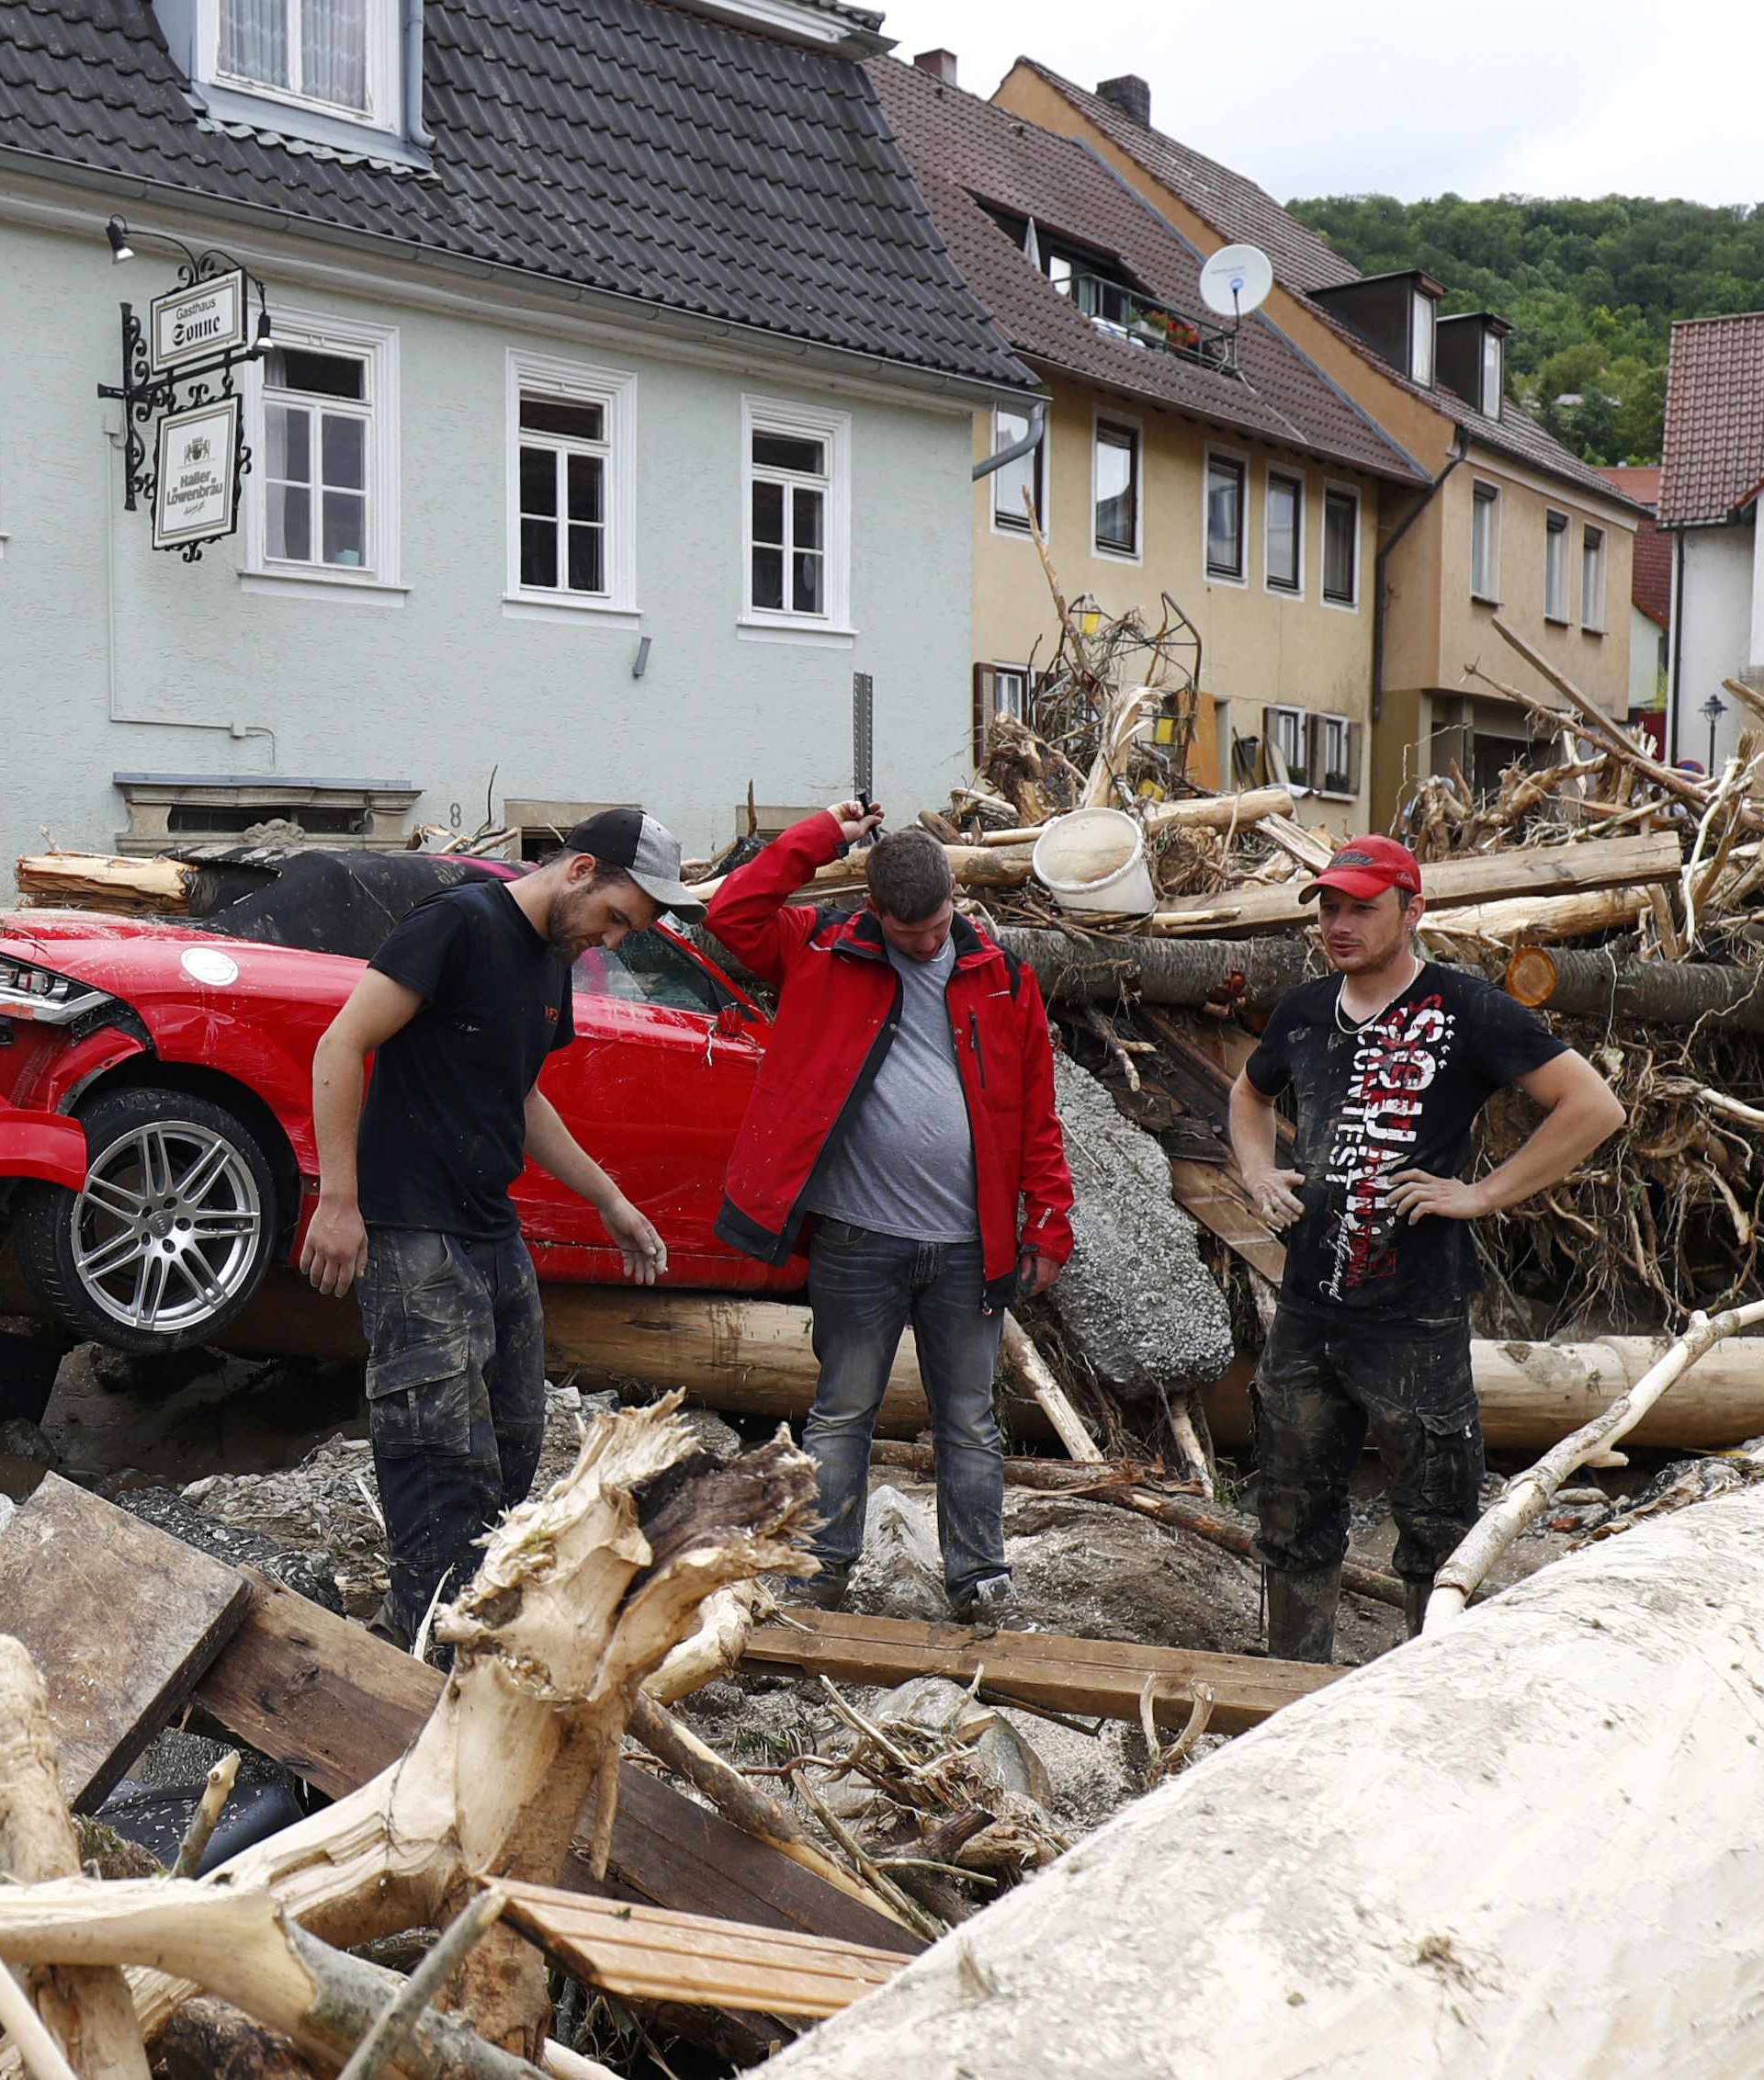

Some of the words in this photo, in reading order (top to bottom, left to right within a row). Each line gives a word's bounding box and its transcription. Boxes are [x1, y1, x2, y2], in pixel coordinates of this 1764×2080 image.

[175, 298, 217, 321] Gasthaus
[172, 316, 220, 346] Sonne
[166, 477, 223, 506] Löwenbräu
[180, 470, 212, 489] Haller
[449, 801, 461, 829] 8
[1324, 1023, 1389, 1192] CONTEST
